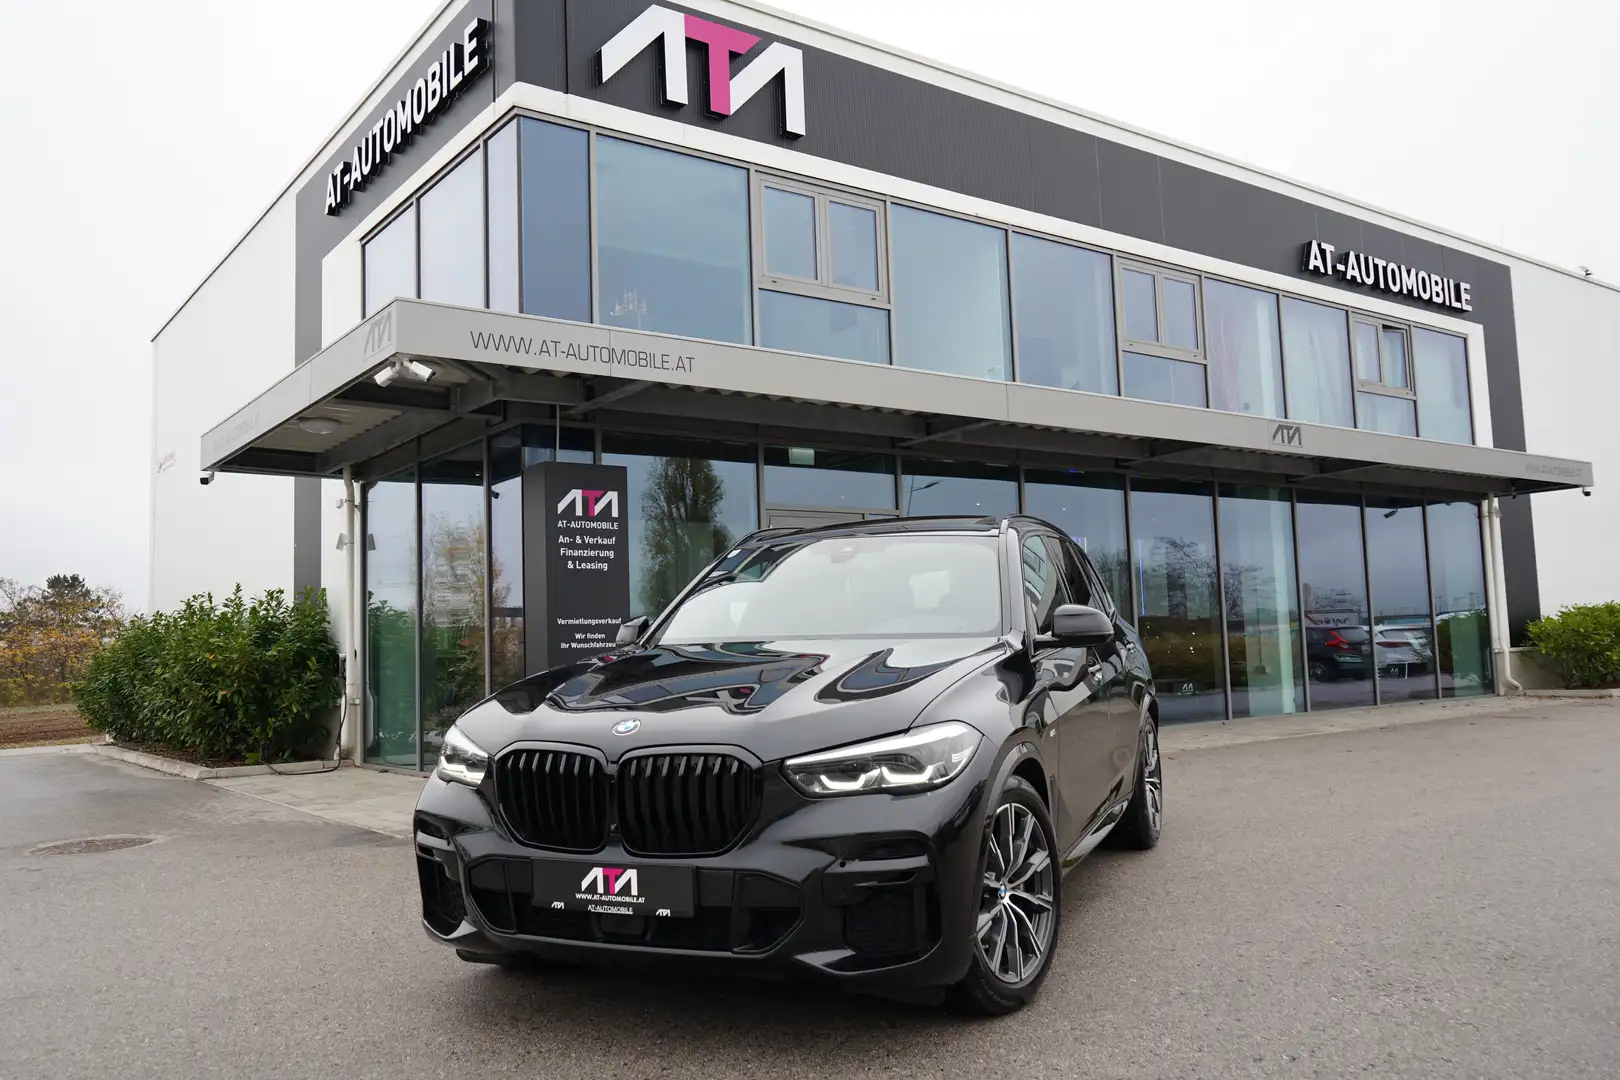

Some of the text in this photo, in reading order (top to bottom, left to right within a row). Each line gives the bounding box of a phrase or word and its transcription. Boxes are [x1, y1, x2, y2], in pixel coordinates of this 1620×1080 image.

[324, 17, 481, 215] AT-AUTOMOBILE
[1307, 239, 1473, 312] AT-AUTOMOBILE
[469, 331, 696, 373] WWW.AT-AUTOMOBILE.AT
[557, 520, 619, 530] AT-AUTOMOBILE
[558, 535, 616, 545] An- & Verkauf
[560, 547, 615, 559] Finanzierung
[567, 560, 608, 571] & Leasing
[575, 632, 606, 640] Wir finden
[571, 641, 617, 649] Wunschfahrzeu
[575, 893, 645, 904] WWW.AT-AUTOMOBILE.AT
[587, 904, 633, 914] AT-AUTOMOBILE
